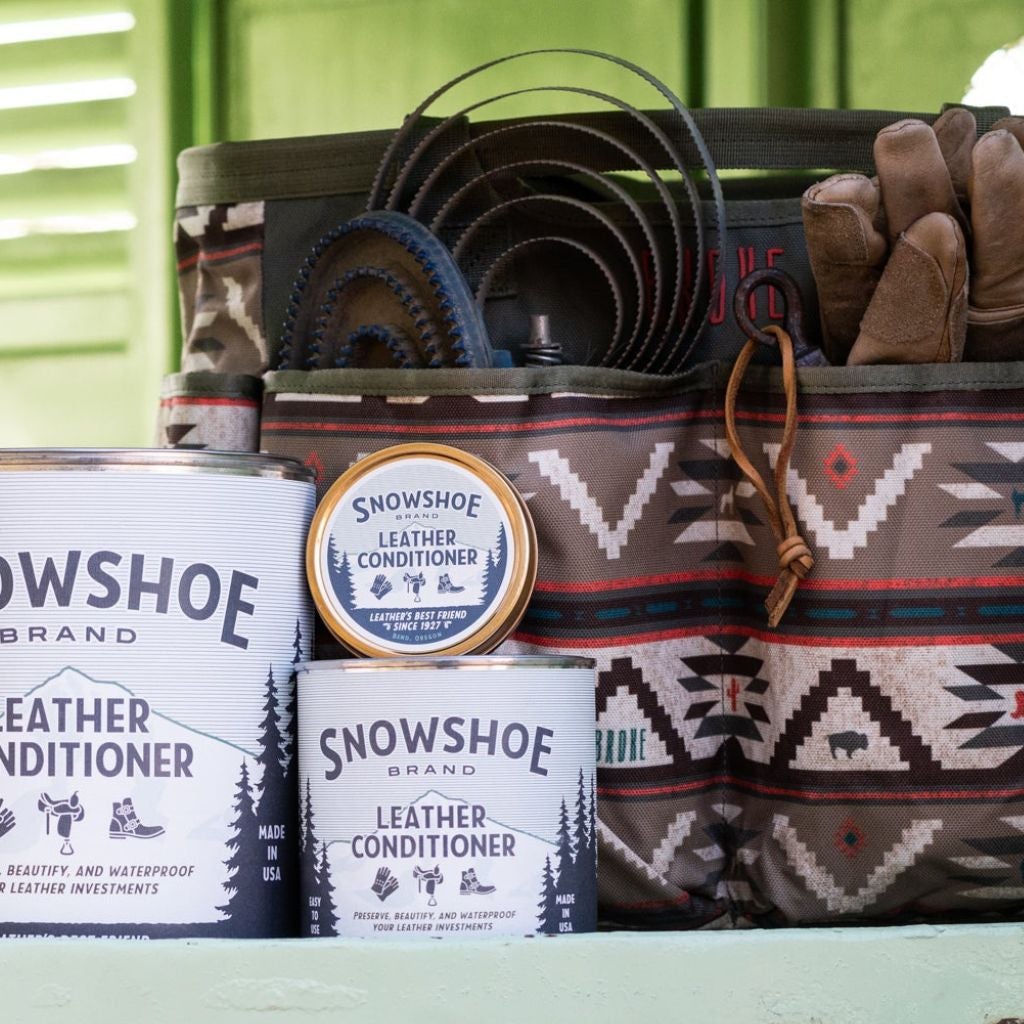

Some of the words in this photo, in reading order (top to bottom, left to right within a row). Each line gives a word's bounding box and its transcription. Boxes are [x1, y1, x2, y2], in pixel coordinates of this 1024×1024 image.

[352, 490, 482, 523] SNOWSHOE
[396, 513, 439, 521] BRAND
[379, 529, 456, 548] LEATHER
[357, 549, 478, 569] CONDITIONER
[370, 611, 412, 622] LEATHER'S
[414, 611, 435, 620] BEST
[437, 610, 467, 620] FRIEND
[393, 622, 418, 631] SINCE
[420, 621, 441, 631] 1927
[0, 626, 136, 644] BRAND
[319, 716, 554, 780] SNOWSHOE
[388, 764, 476, 777] BRAND
[376, 805, 487, 829] LEATHER
[258, 824, 285, 839] MADE
[351, 833, 516, 858] CONDITIONER
[267, 845, 277, 861] IN
[7, 864, 71, 878] BEAUTIFY,
[76, 865, 104, 877] AND
[109, 865, 195, 878] WATERPROOF
[263, 866, 281, 881] USA
[10, 881, 66, 895] LEATHER
[70, 882, 159, 895] INVESTMENTS
[309, 896, 321, 907] EASY
[555, 895, 575, 905] MADE
[311, 910, 319, 920] TO
[353, 912, 391, 920] PRESERVE,
[394, 912, 435, 920] BEAUTIFY,
[439, 912, 457, 920] AND
[460, 911, 517, 919] WATERPROOF
[562, 908, 569, 918] IN
[311, 924, 320, 935] USE
[373, 923, 394, 931] YOUR
[396, 923, 432, 932] LEATHER
[435, 922, 494, 931] INVESTMENTS
[559, 921, 573, 932] USA
